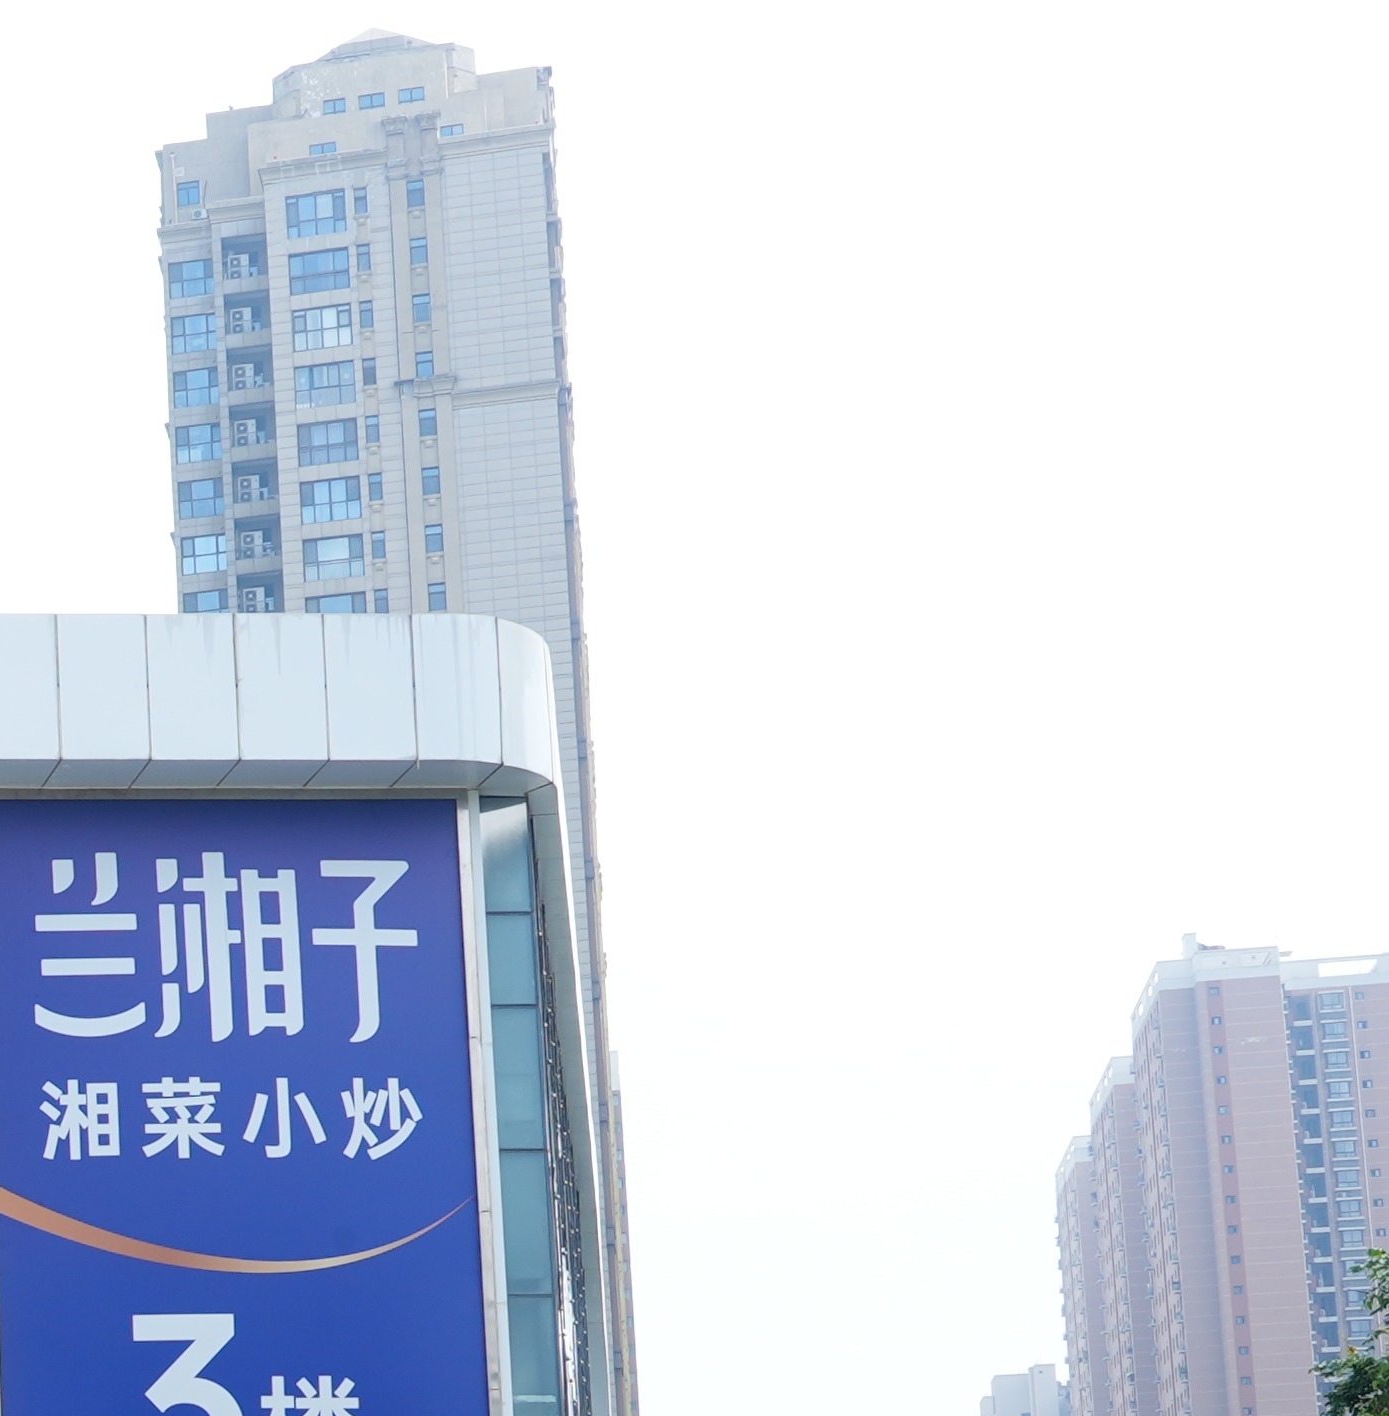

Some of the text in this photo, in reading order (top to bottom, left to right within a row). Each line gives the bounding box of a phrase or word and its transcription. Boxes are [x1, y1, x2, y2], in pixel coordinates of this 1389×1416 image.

[34, 852, 419, 1043] 兰湘子
[39, 1076, 424, 1161] 湘菜小炒
